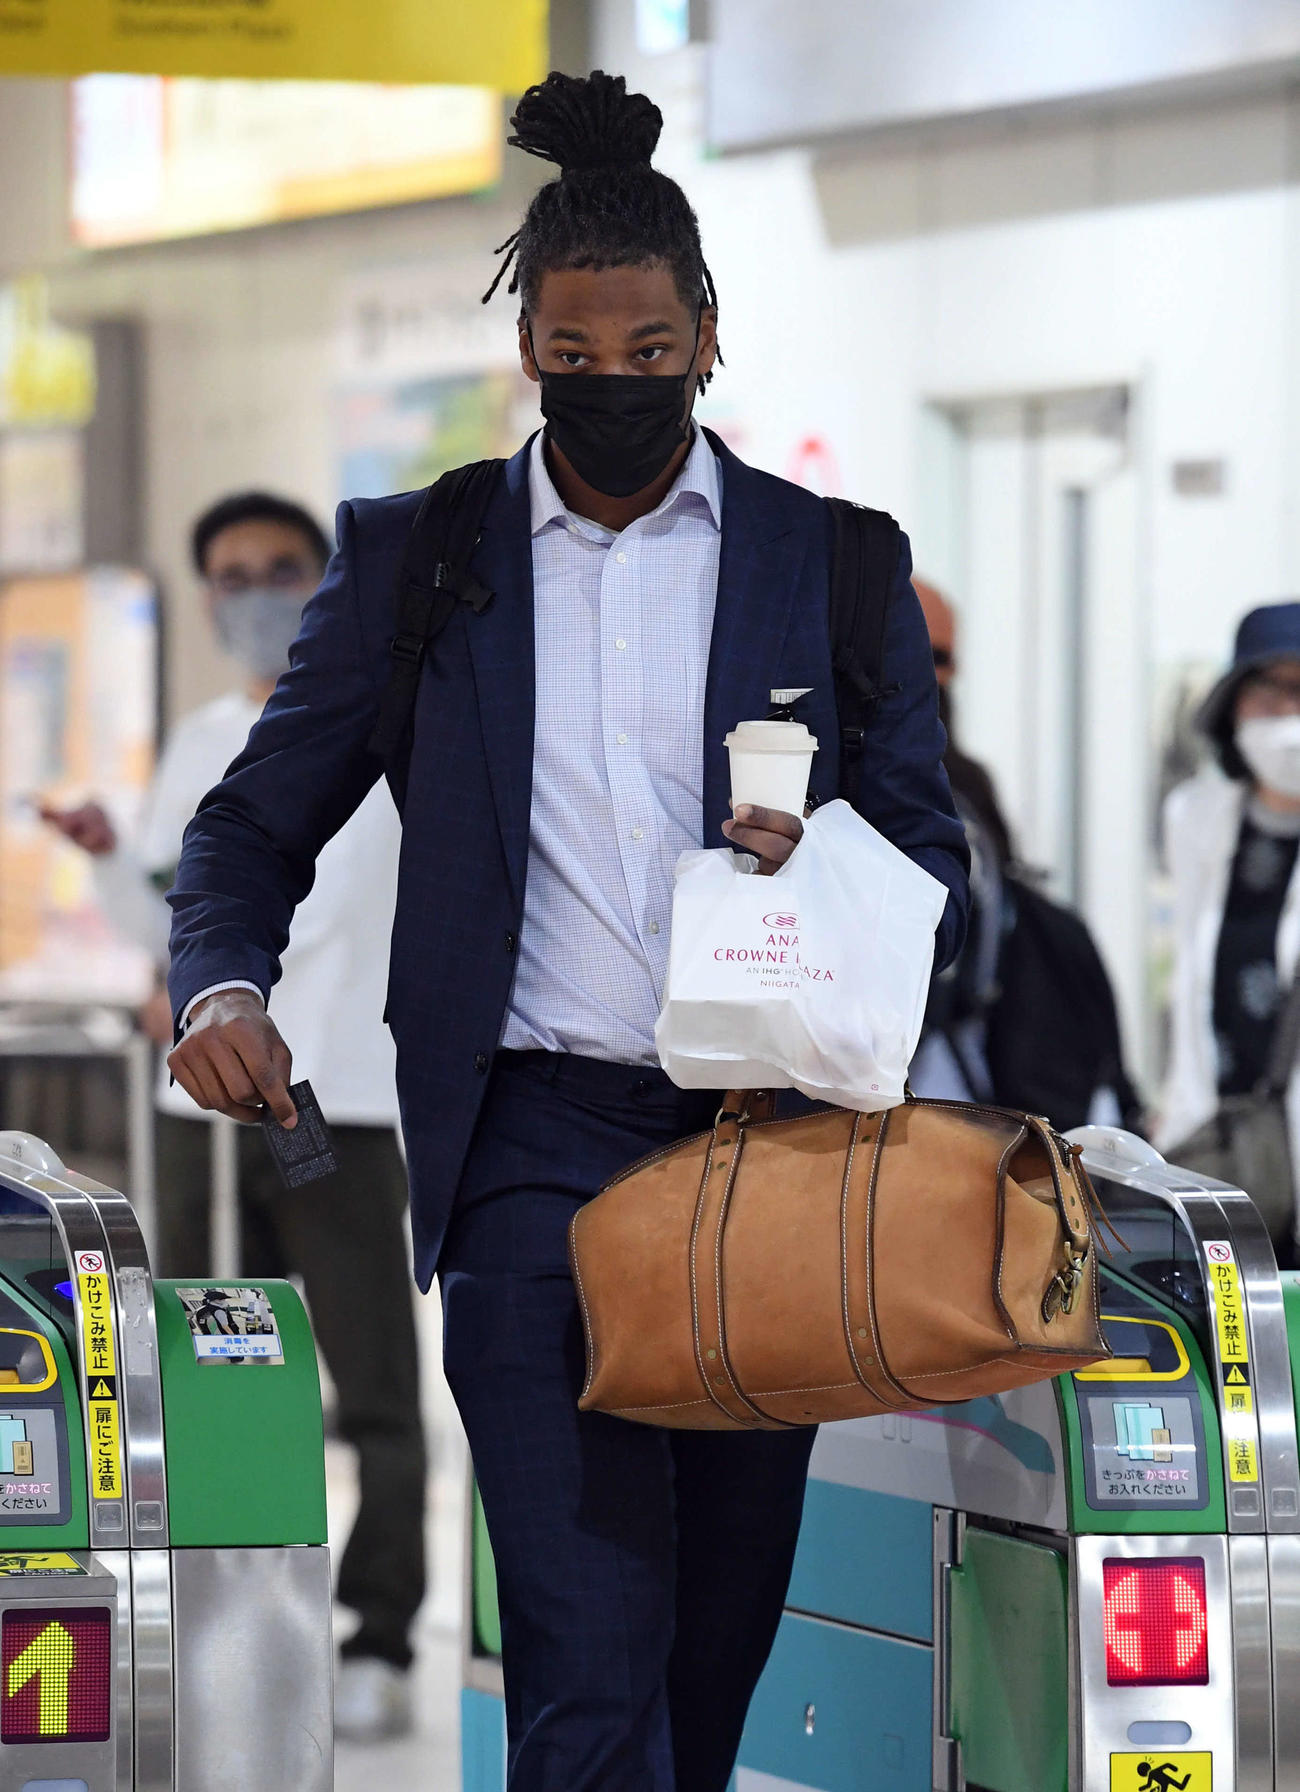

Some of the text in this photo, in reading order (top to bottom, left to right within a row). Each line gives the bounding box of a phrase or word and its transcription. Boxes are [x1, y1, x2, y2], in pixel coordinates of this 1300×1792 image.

[766, 934, 799, 946] ANA
[714, 949, 834, 981] CROWNE AZA
[760, 980, 800, 989] NIIGATA
[1216, 1264, 1242, 1356] かけこみ禁止
[86, 1275, 109, 1369] かけこみ禁止
[95, 1407, 115, 1491] 扉にご注意
[1108, 1483, 1187, 1495] お入れください
[2, 1497, 47, 1509] ください
